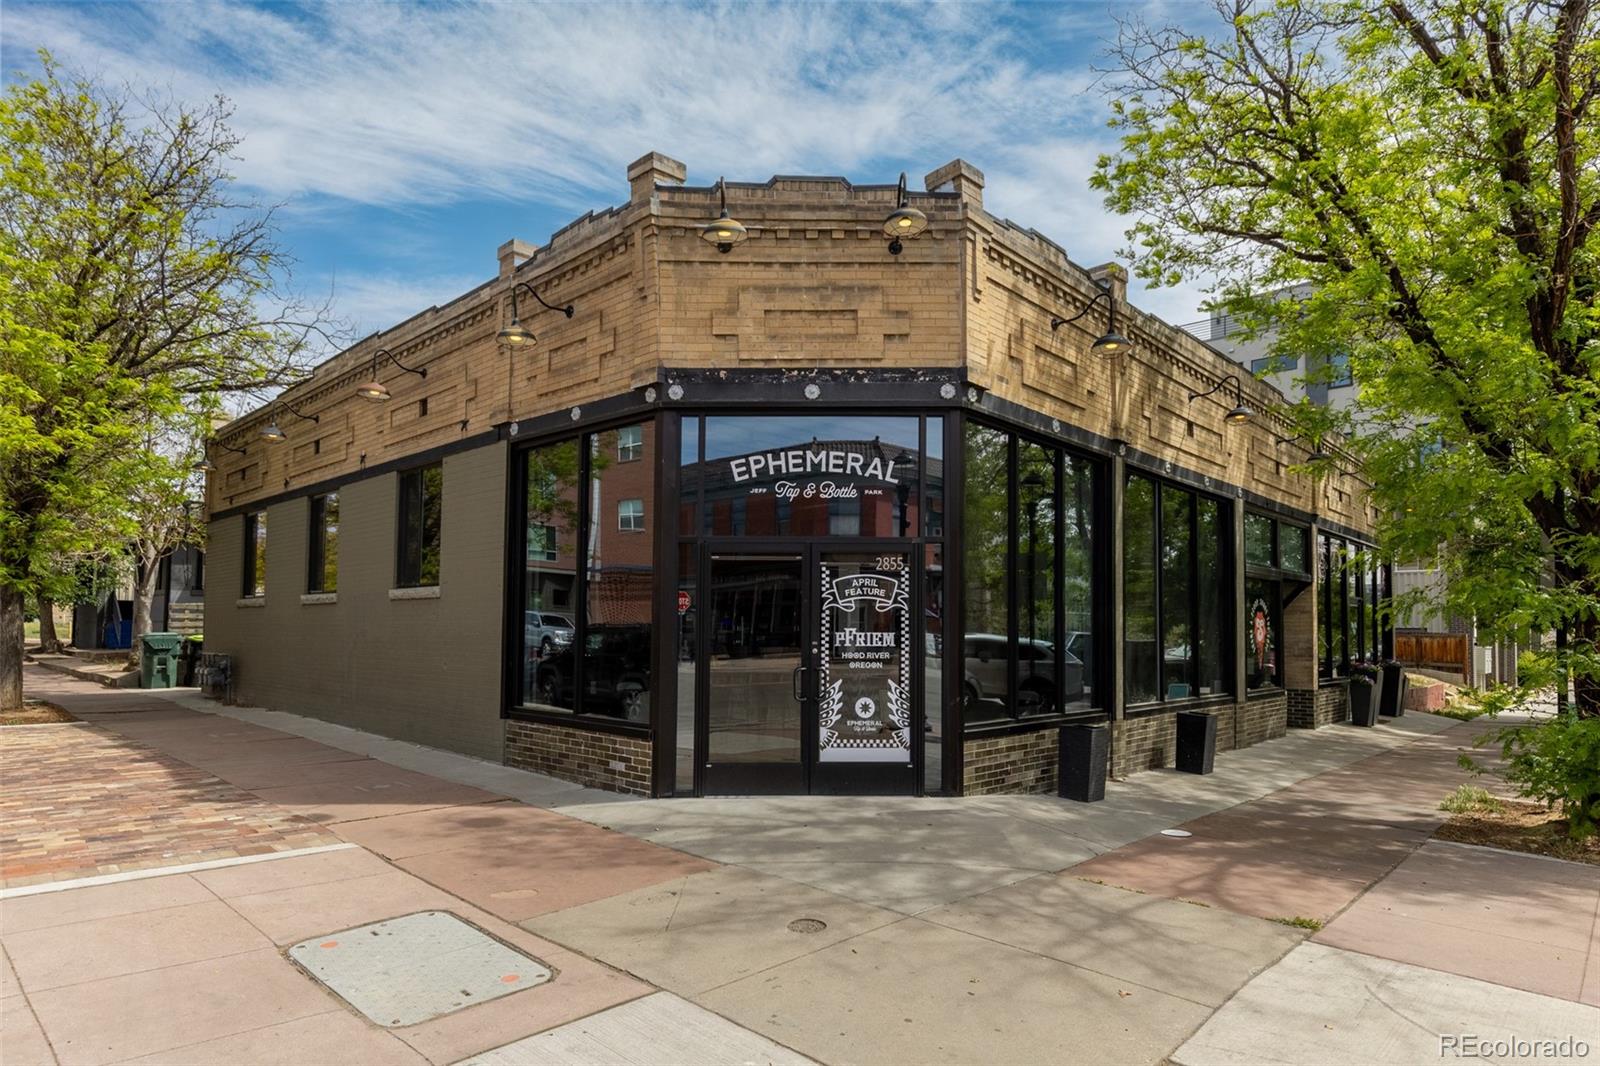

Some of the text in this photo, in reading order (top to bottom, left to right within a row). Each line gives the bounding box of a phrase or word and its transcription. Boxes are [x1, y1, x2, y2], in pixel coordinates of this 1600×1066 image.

[730, 450, 899, 484] EPHEMERAL
[775, 480, 858, 502] Tap & Bottle
[875, 557, 904, 571] 2855
[852, 579, 879, 588] APRIL
[845, 587, 887, 597] FEATURE
